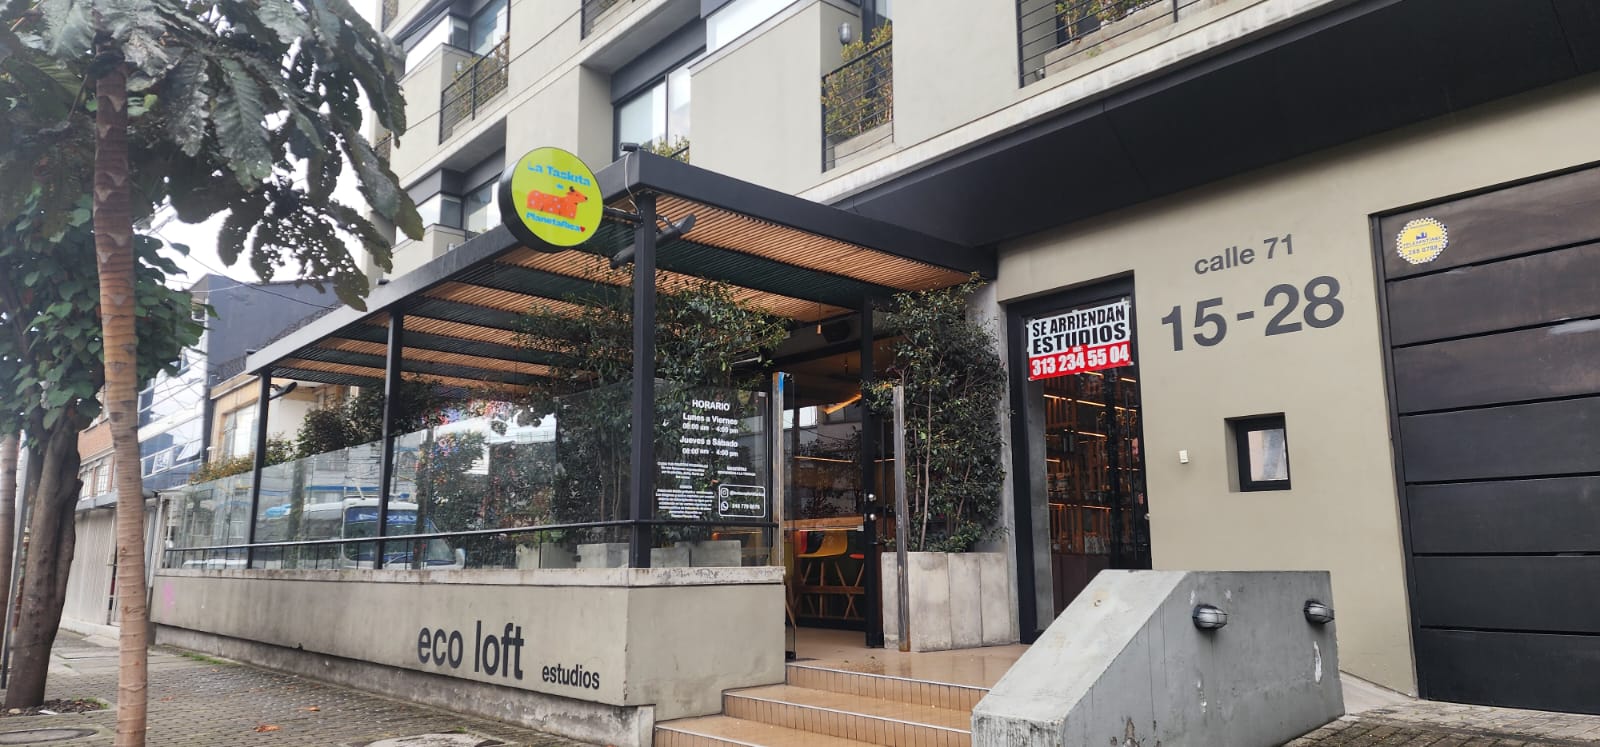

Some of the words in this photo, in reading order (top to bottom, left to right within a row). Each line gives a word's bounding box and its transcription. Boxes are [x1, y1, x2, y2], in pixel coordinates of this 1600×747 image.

[527, 161, 543, 173] La
[1194, 246, 1255, 275] calle
[1263, 233, 1293, 260] 71
[1032, 321, 1047, 337] SE
[1050, 305, 1125, 335] ARRIENDAN
[1033, 322, 1126, 355] ESTUDIOS
[1032, 357, 1056, 376] 313
[1058, 351, 1085, 372] 234
[1087, 347, 1107, 367] 55
[1109, 344, 1129, 364] 04
[683, 412, 705, 422] Lunes
[712, 415, 739, 426] Viernes
[692, 399, 730, 411] HORARIO
[679, 435, 705, 445] Jueves
[712, 437, 739, 448] Sábado
[417, 627, 464, 669] eco
[474, 620, 524, 680] loft
[542, 663, 601, 690] estudios
